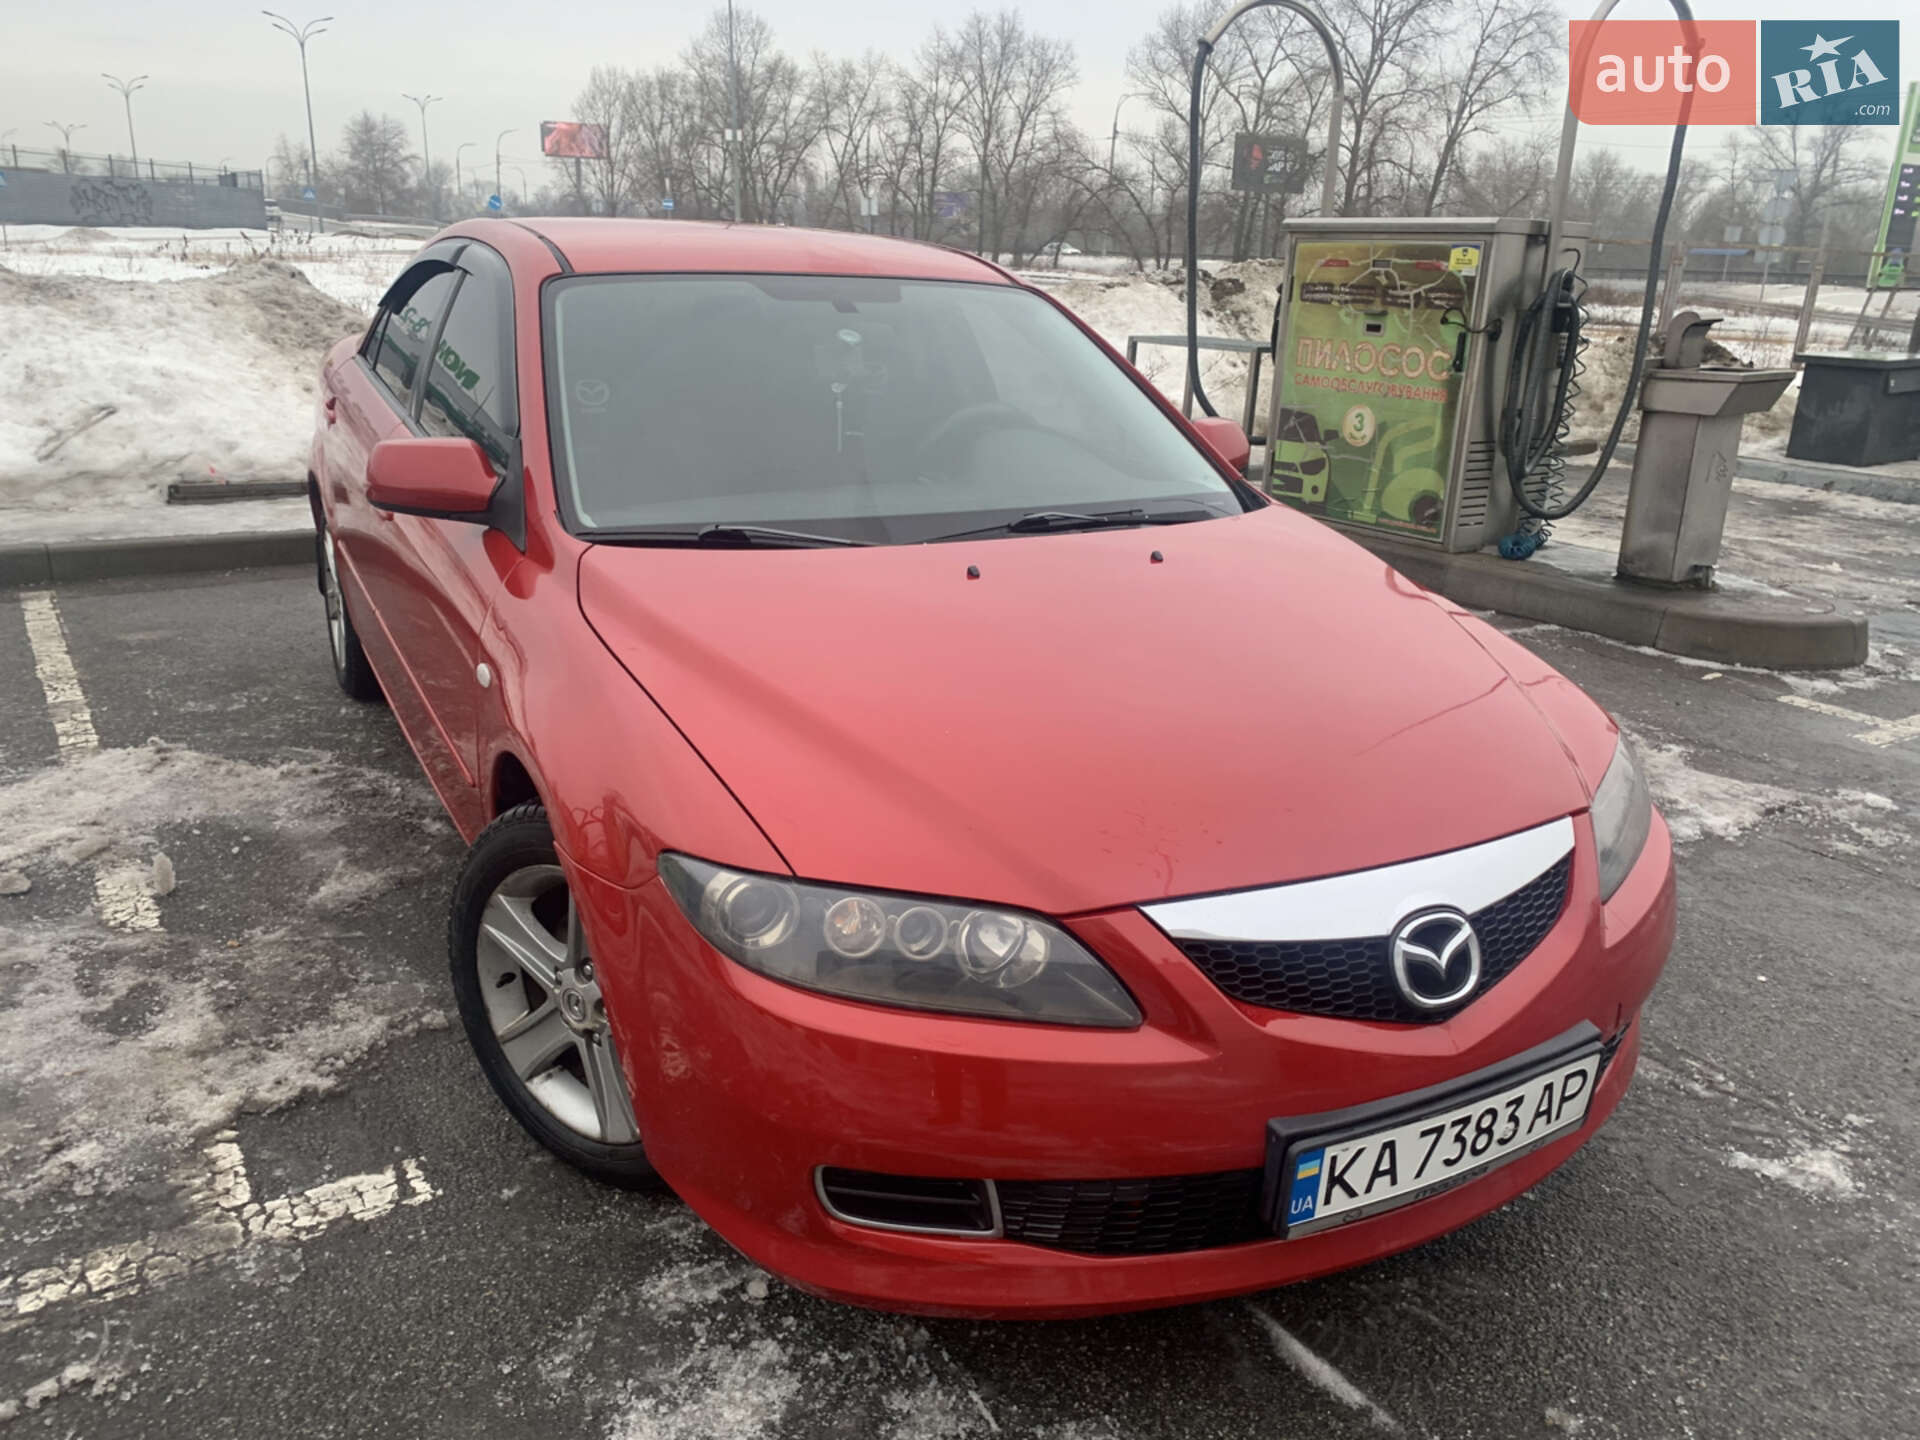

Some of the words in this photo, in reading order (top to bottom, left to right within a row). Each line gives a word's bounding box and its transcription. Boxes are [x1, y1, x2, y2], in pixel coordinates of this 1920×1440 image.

[1296, 337, 1453, 382] ПИЛОСОС
[1353, 412, 1365, 432] 3
[1322, 1139, 1398, 1206] KA
[1414, 1095, 1526, 1180] 7383
[1527, 1068, 1589, 1134] AP
[1291, 1195, 1314, 1215] UA
